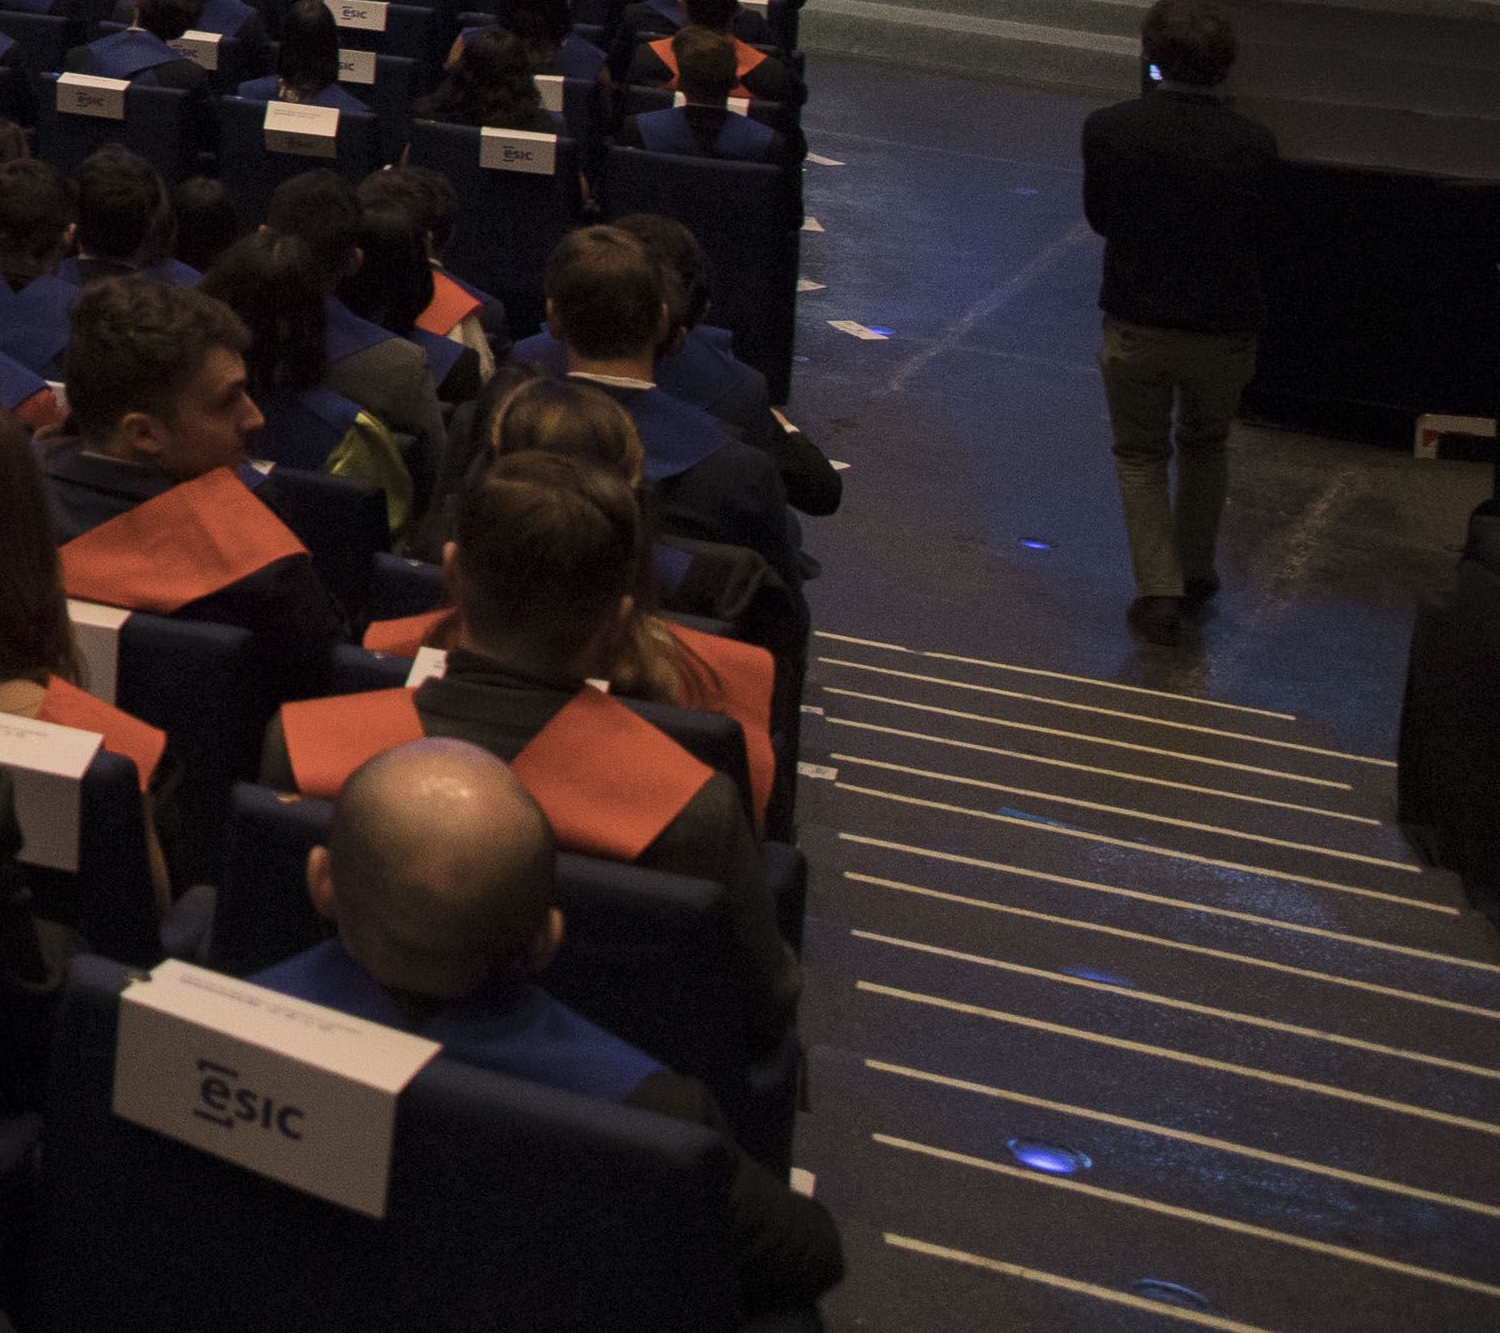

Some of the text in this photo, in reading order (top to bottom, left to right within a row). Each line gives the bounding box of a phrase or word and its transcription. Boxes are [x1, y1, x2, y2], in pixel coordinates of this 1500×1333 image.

[342, 8, 367, 20] esic
[502, 144, 533, 162] esic
[201, 1077, 305, 1141] esic
